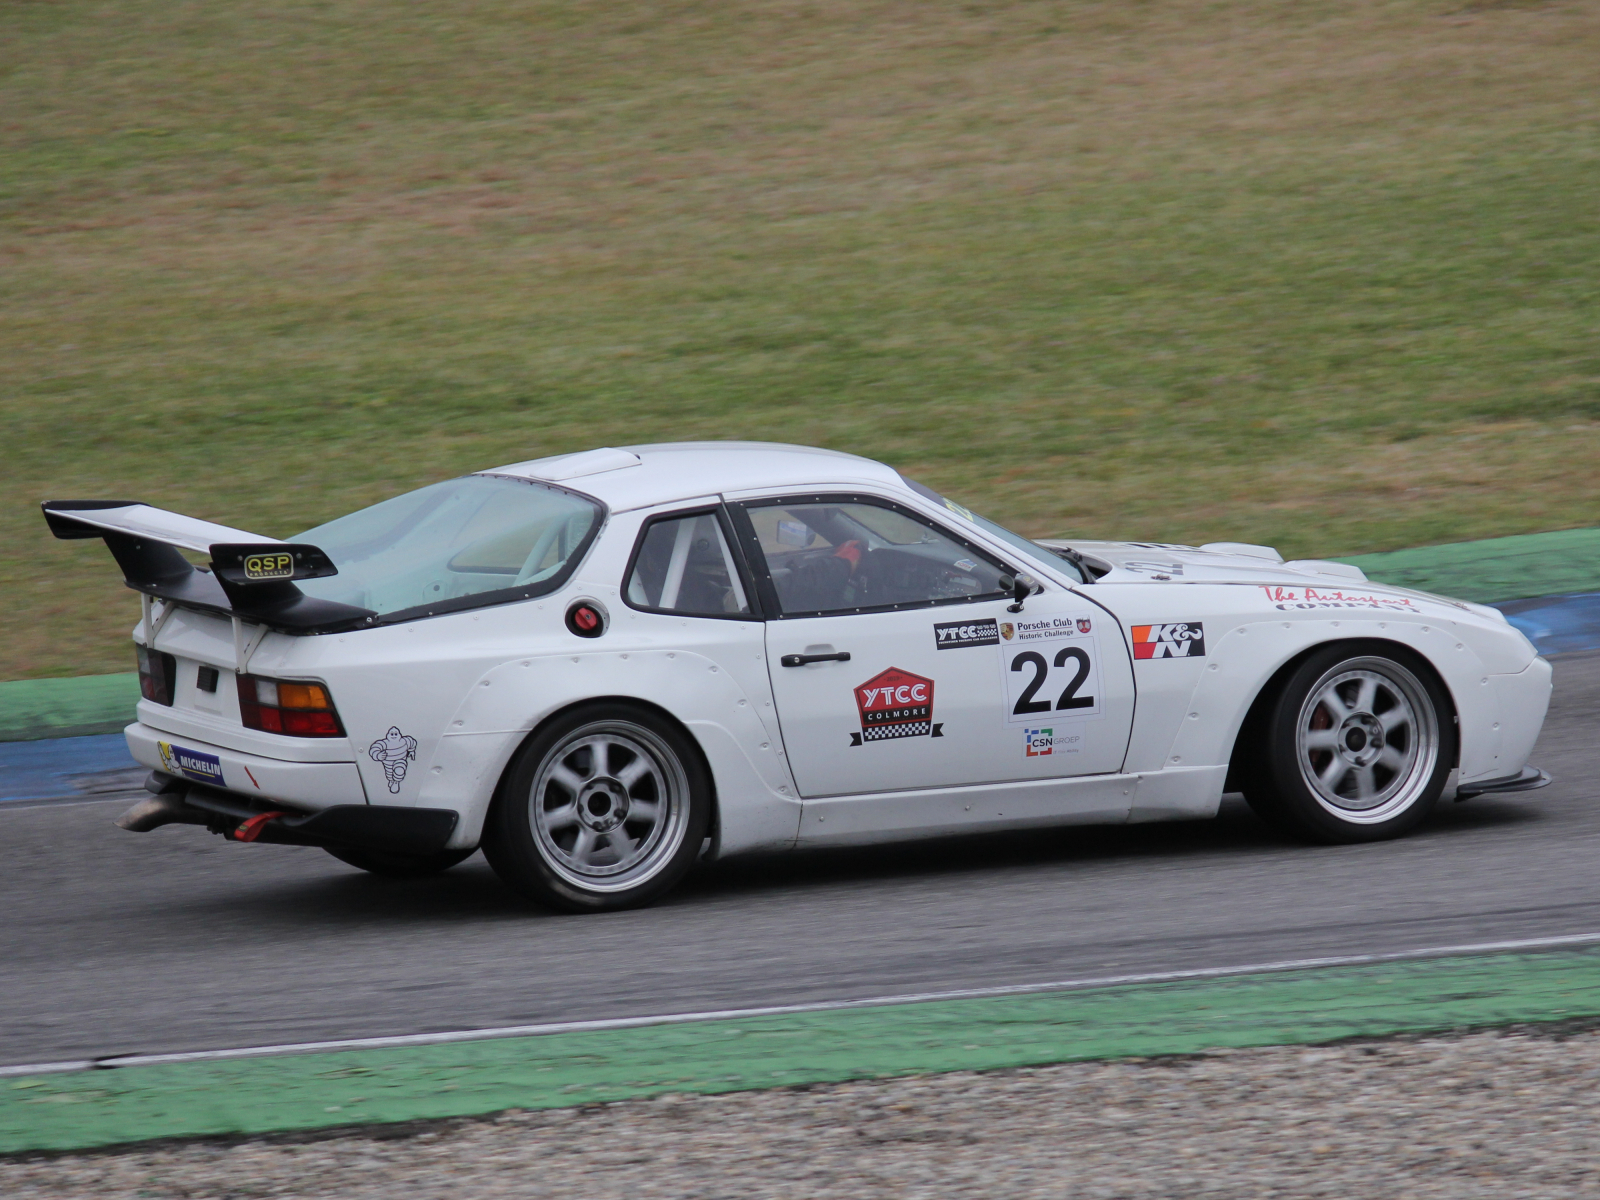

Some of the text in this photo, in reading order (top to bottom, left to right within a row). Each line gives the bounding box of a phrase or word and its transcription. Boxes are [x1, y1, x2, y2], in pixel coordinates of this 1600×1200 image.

[247, 556, 290, 572] QSP
[1258, 585, 1416, 607] The Autosport
[1017, 617, 1073, 631] Porsche Club
[936, 625, 977, 641] YTCC
[1018, 628, 1074, 640] Historic Challenge
[1010, 646, 1095, 715] 22
[862, 683, 927, 708] YTCC
[868, 708, 926, 720] COLMORE
[1032, 737, 1053, 748] CSN
[180, 755, 221, 776] MICHELIN
